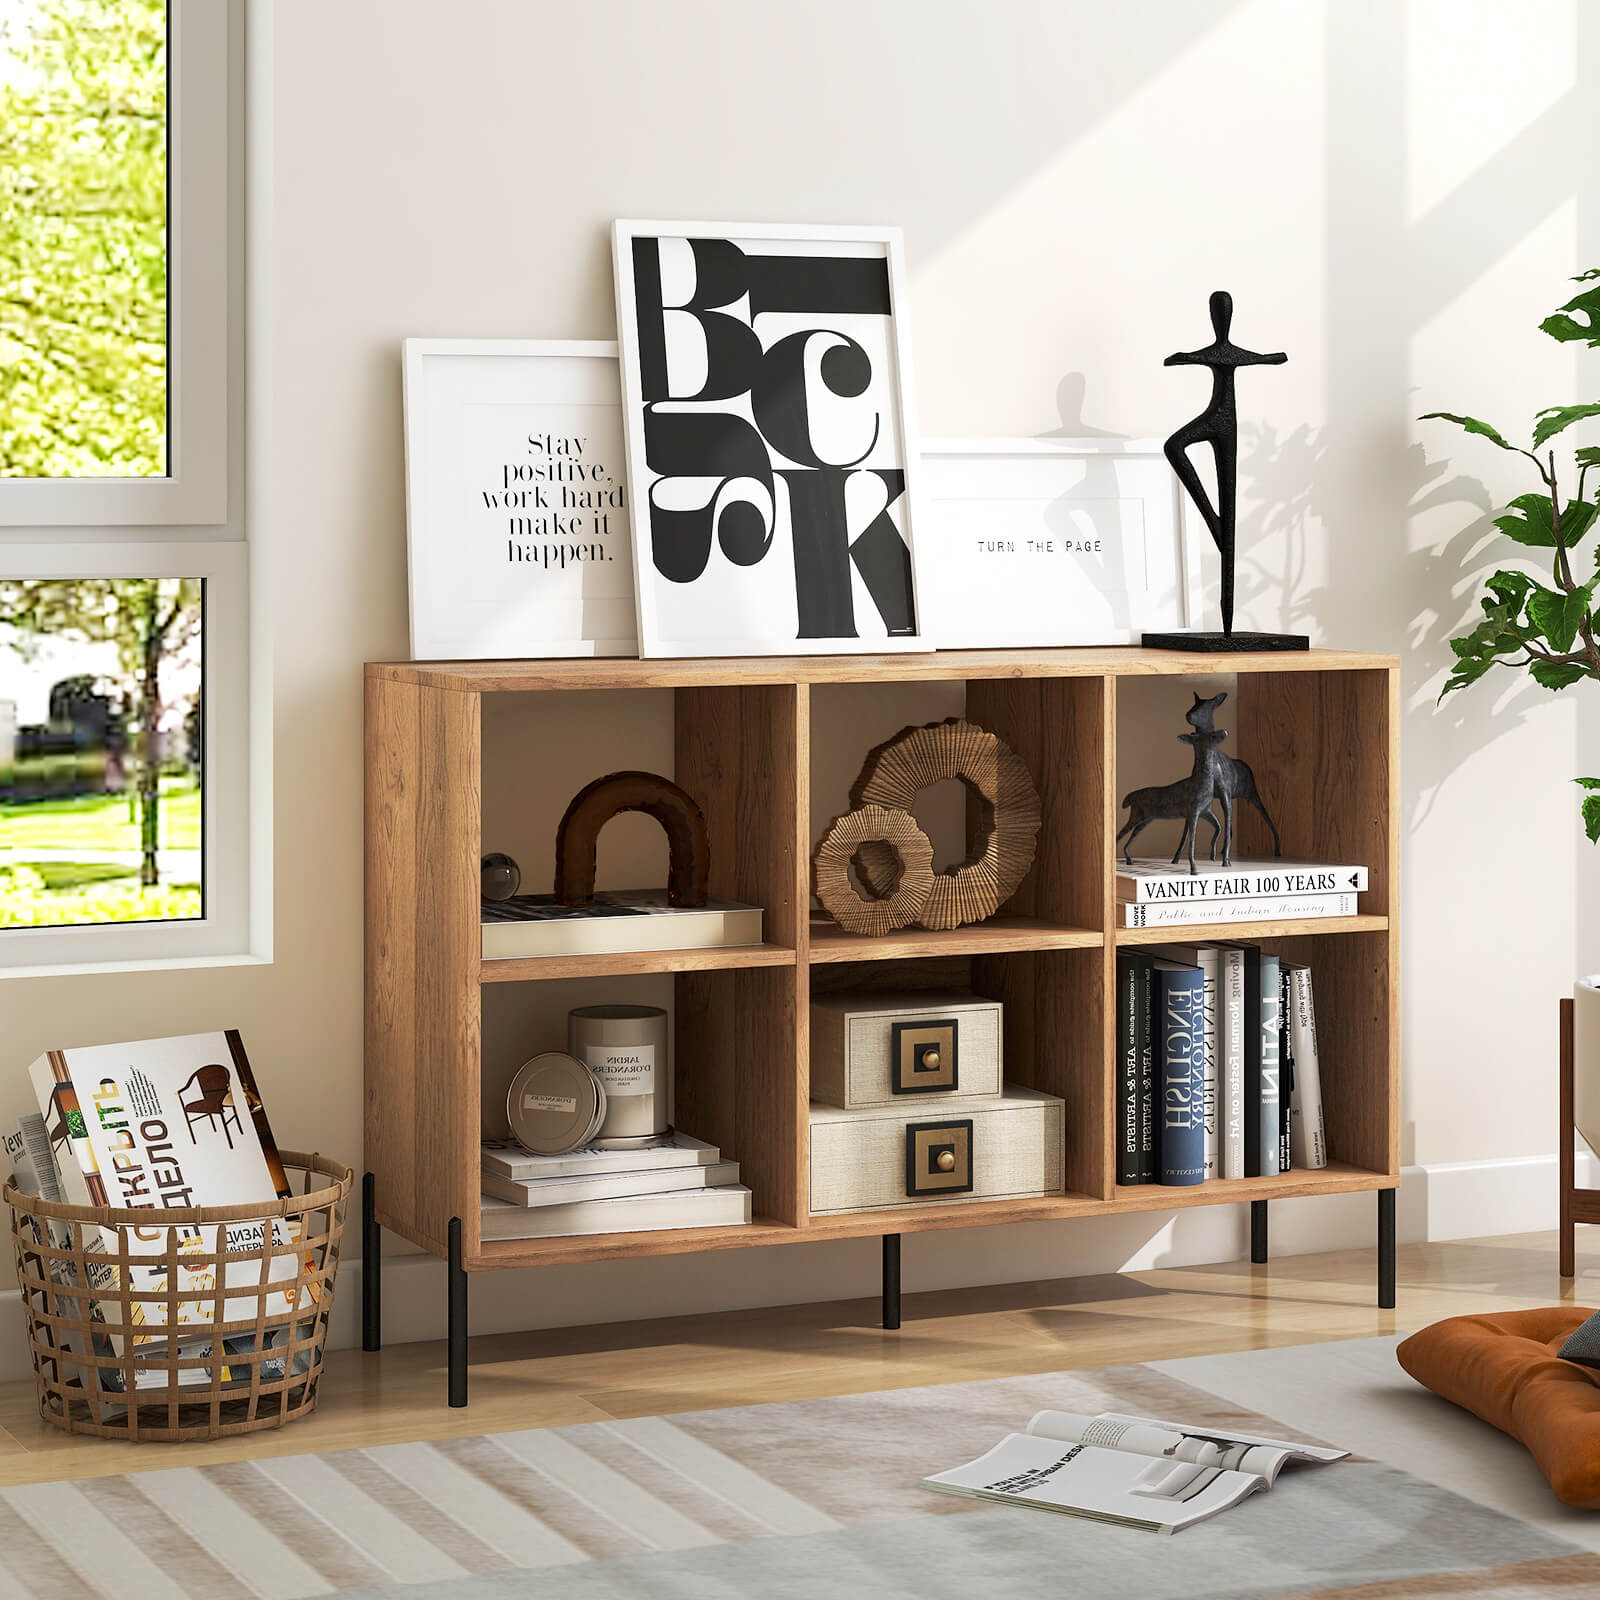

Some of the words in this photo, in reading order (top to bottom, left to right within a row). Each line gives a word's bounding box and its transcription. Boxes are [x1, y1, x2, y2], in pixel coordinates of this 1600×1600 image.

[528, 433, 588, 462] Stay
[503, 458, 614, 489] positive,
[482, 486, 549, 509] work
[562, 485, 624, 508] hard
[510, 512, 582, 535] make
[594, 510, 613, 535] it
[508, 540, 613, 569] happen.
[977, 541, 1015, 552] TURN
[1026, 540, 1054, 552] THE
[1065, 540, 1102, 552] PAGE
[1145, 880, 1209, 899] VANITY
[1214, 878, 1250, 896] FAIR
[1256, 877, 1280, 893] 100
[1285, 873, 1336, 891] YEARS
